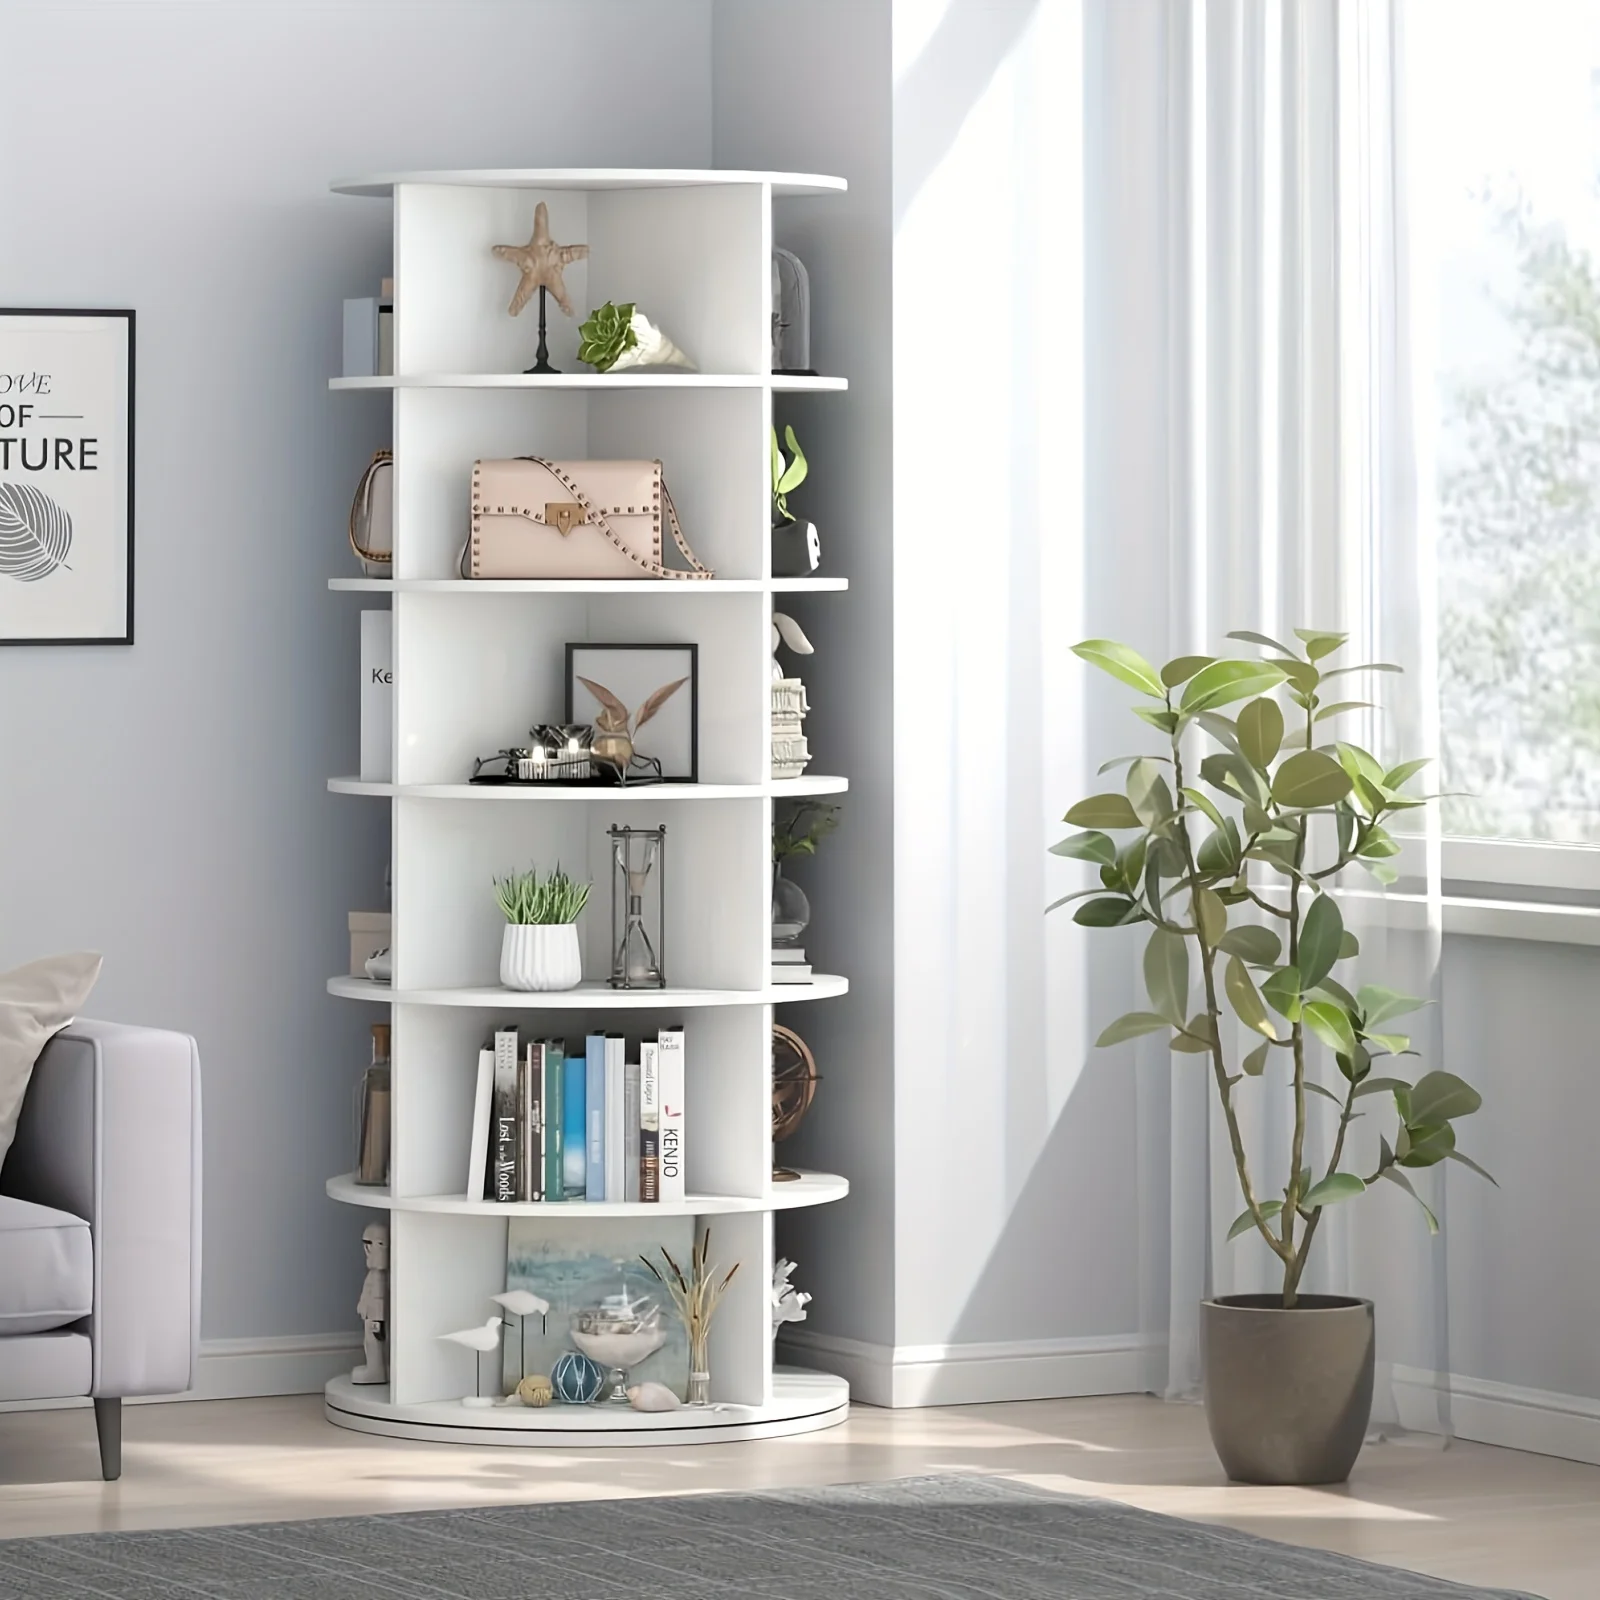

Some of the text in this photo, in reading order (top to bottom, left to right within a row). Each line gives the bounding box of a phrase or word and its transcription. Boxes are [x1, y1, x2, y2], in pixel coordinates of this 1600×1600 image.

[0, 404, 34, 428] OF
[0, 438, 98, 471] TURE
[372, 668, 393, 684] Ke
[499, 1117, 515, 1142] Lost
[663, 1128, 678, 1178] KENJO
[499, 1160, 516, 1201] Woods
